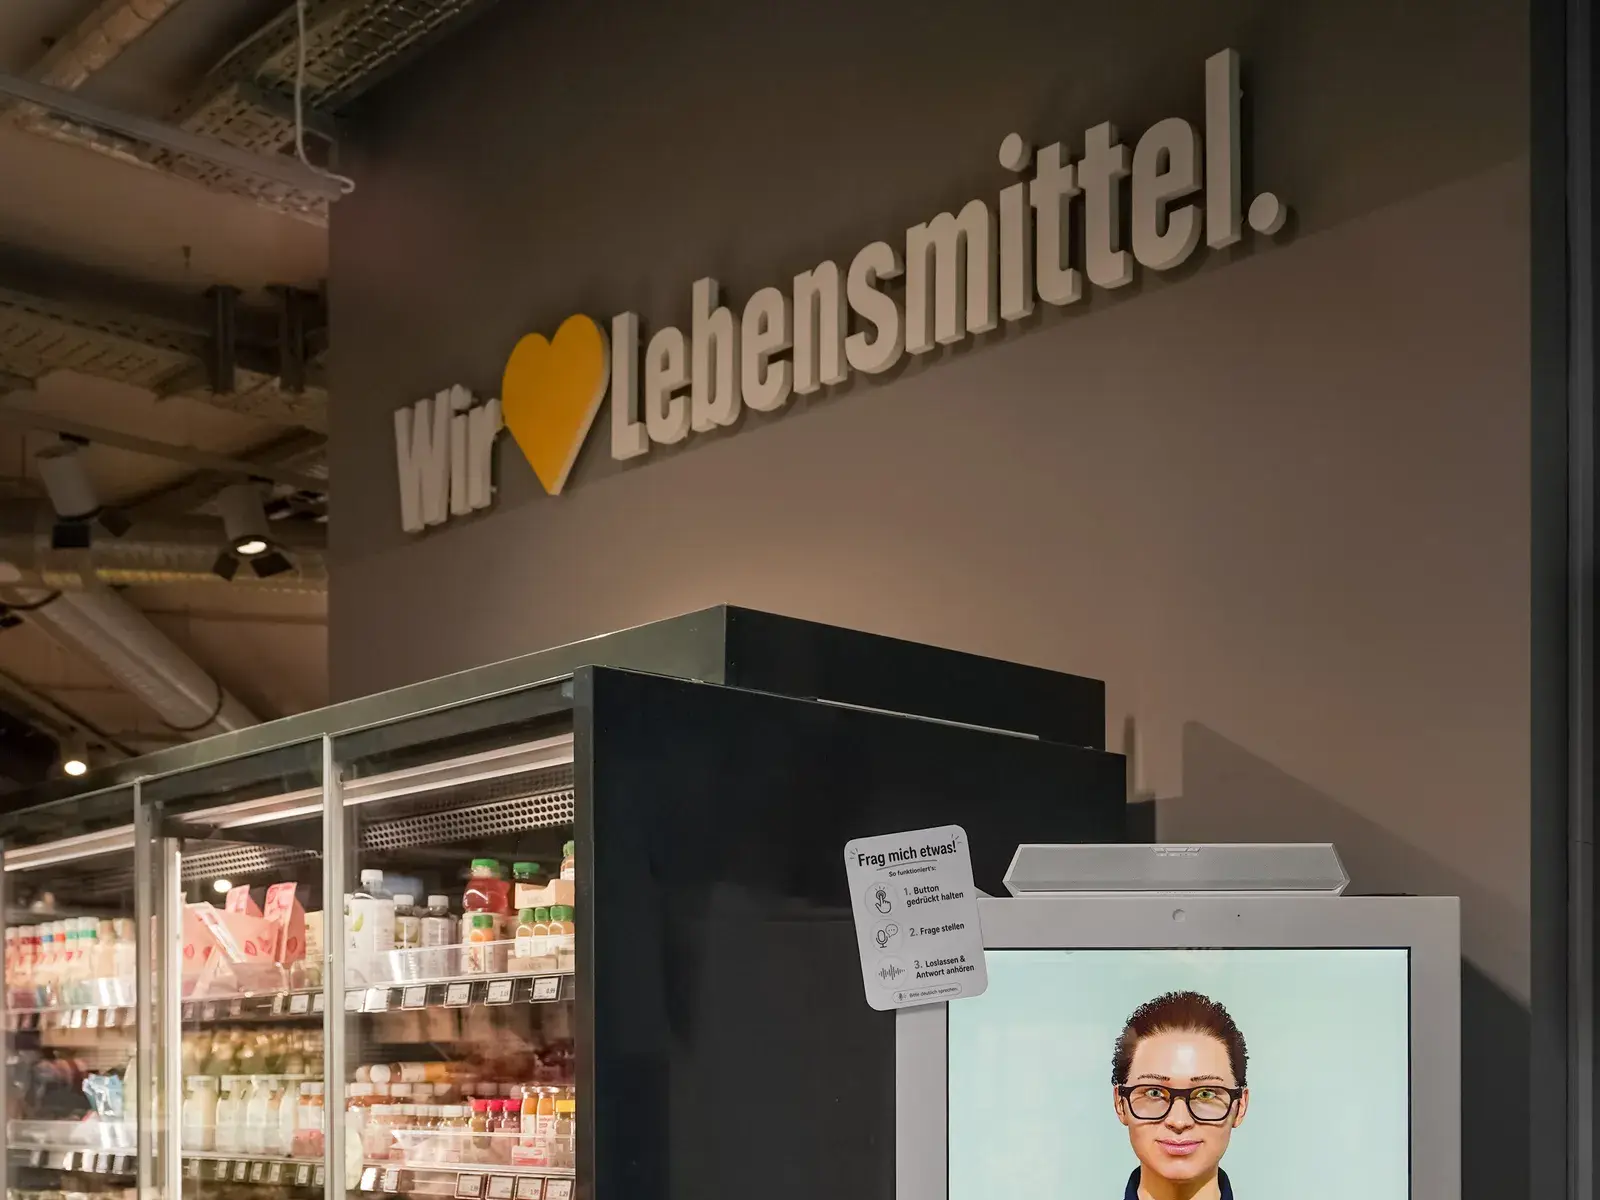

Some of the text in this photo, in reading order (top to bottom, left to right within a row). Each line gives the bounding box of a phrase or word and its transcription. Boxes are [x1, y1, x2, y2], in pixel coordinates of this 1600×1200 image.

[393, 47, 1288, 534] Wir Lebensmittel.
[858, 840, 957, 867] Frag mich etwas!
[904, 886, 940, 896] 1. Button
[906, 892, 964, 908] gedrückt halten
[909, 923, 965, 937] 2. Frage stellen
[914, 960, 923, 969] 3.
[925, 957, 959, 968] Loslassen
[916, 965, 975, 979] Antwort anhören
